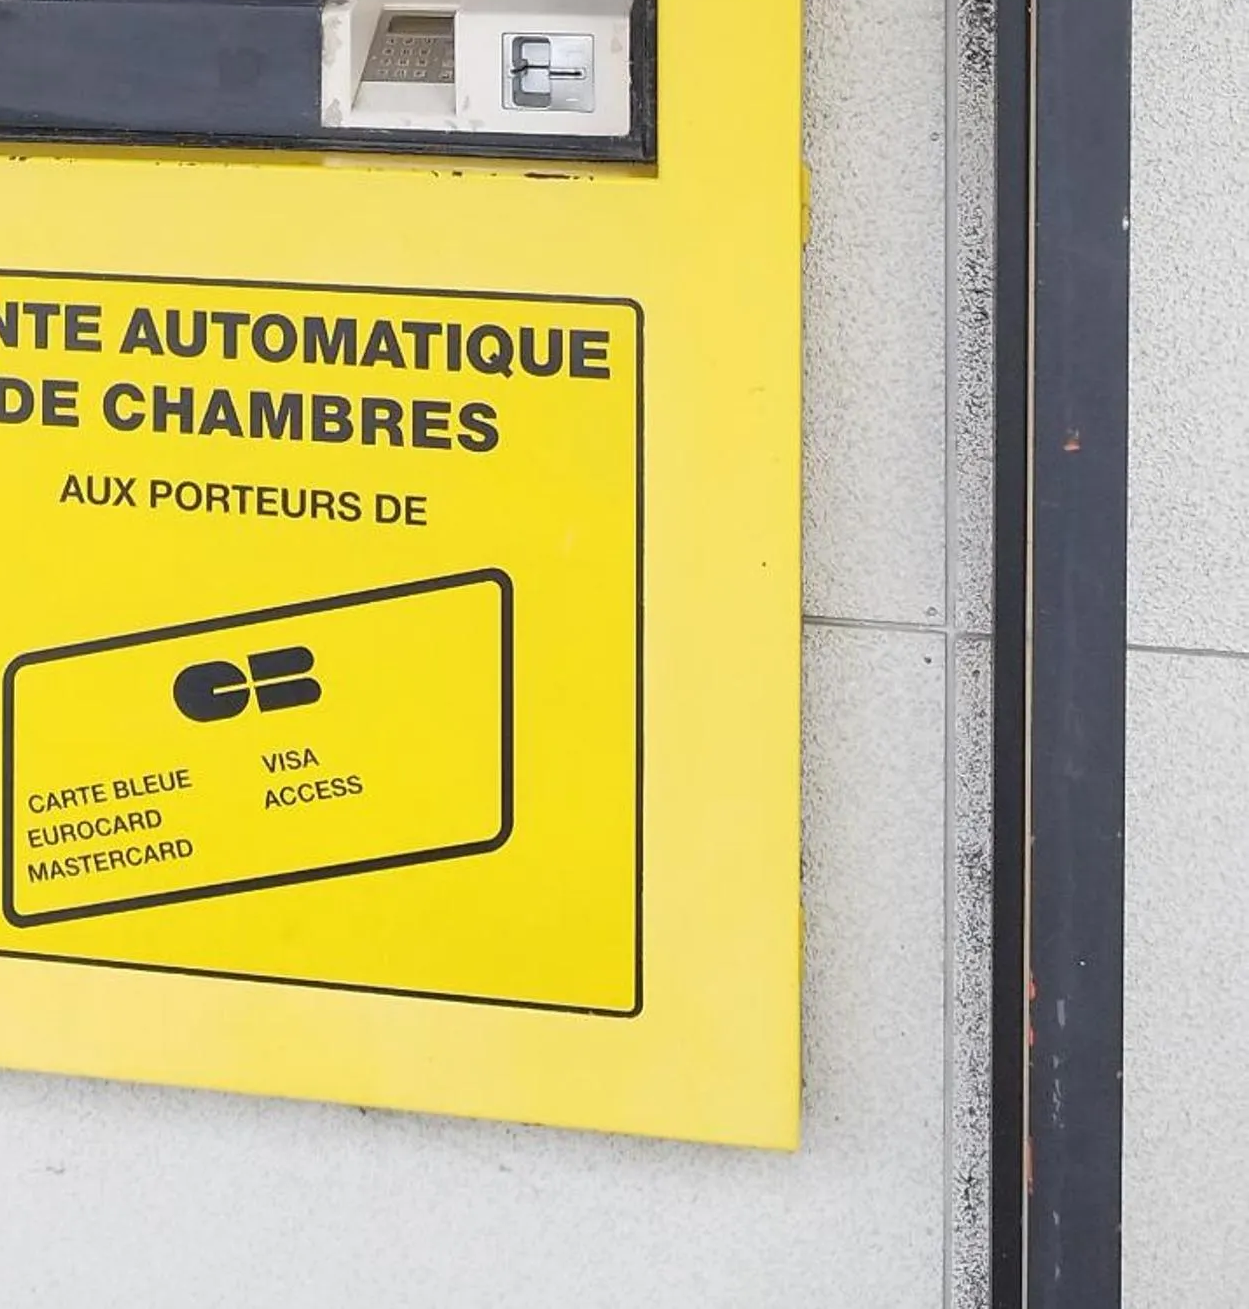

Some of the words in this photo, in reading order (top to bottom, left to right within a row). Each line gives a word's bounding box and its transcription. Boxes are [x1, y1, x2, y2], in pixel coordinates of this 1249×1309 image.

[120, 306, 612, 379] AUTOMATIQUE
[102, 383, 499, 452] CHAMBRES
[60, 475, 136, 508] AUX
[150, 480, 362, 522] PORTEURS
[375, 494, 427, 526] DE
[262, 747, 319, 773] VISA
[28, 784, 106, 814] CARTE
[113, 769, 191, 799] BLEUE
[264, 775, 363, 809] ACCESS
[27, 808, 163, 849] EUROCARD
[27, 838, 193, 883] MASTERCARD
